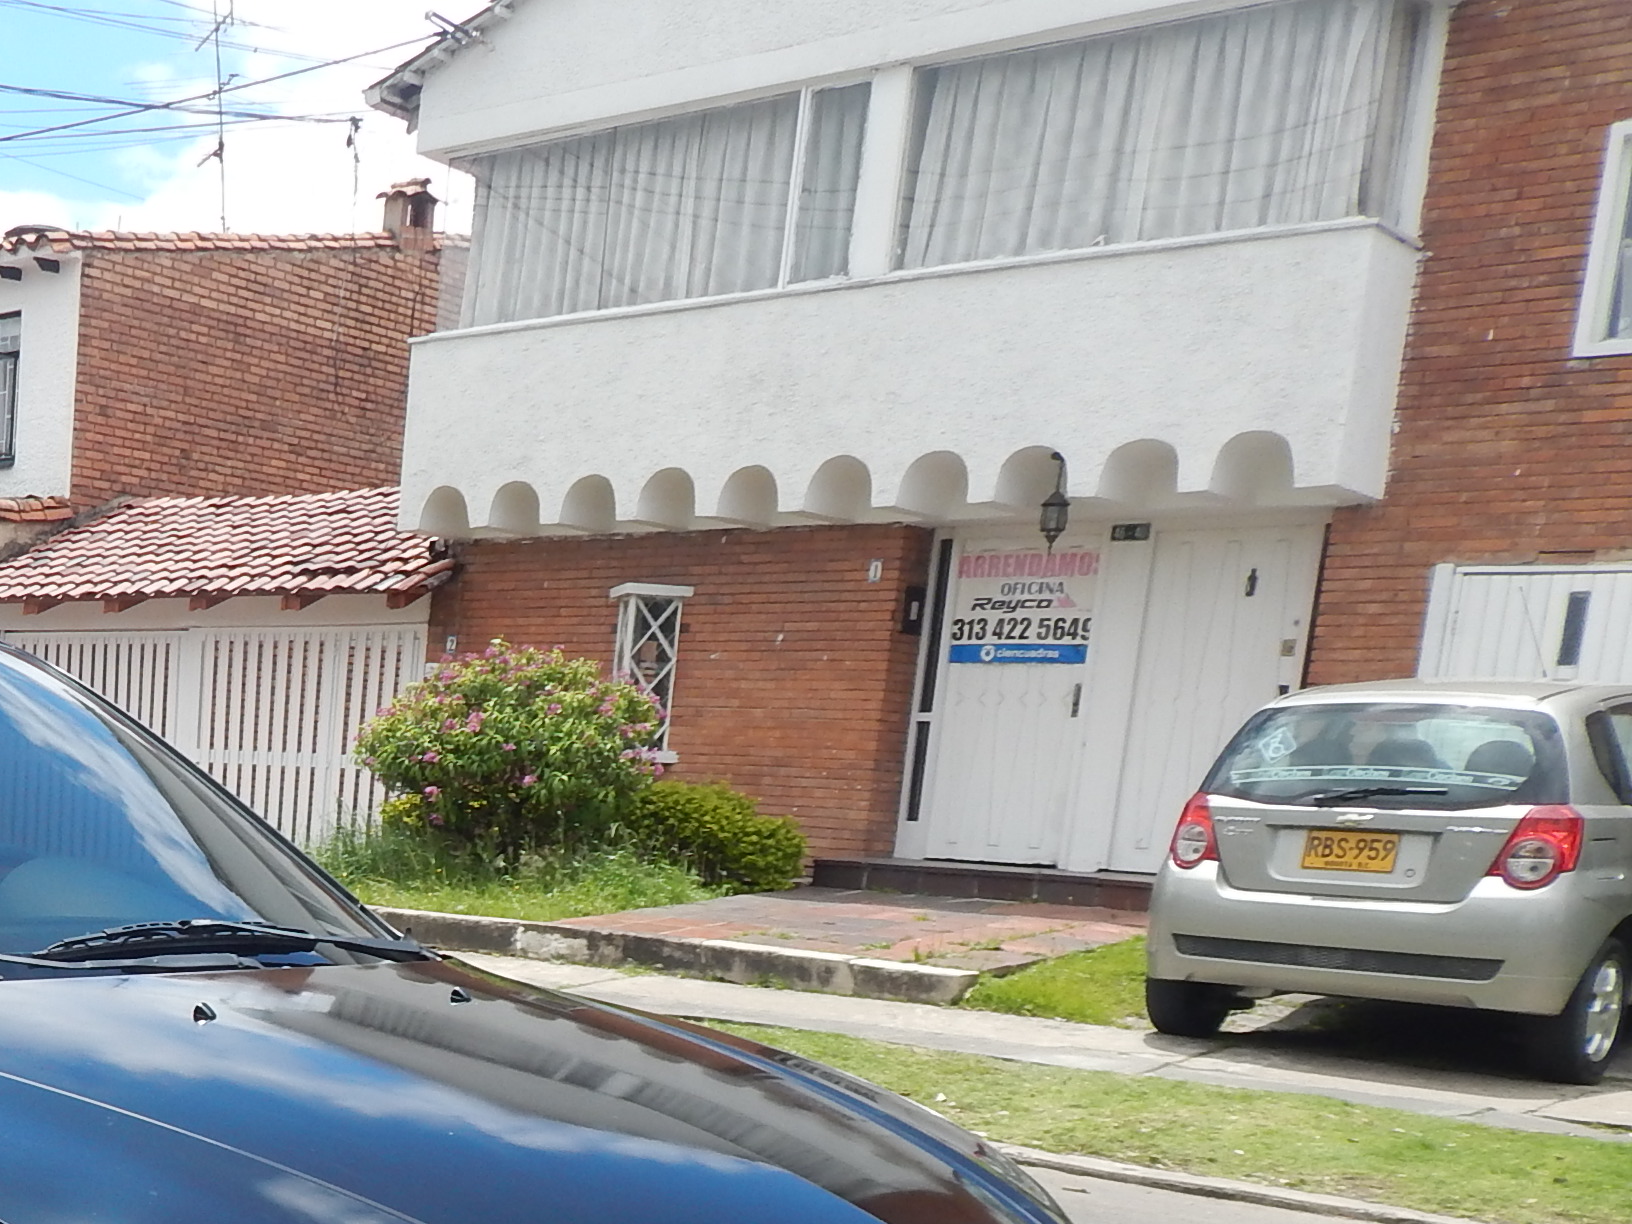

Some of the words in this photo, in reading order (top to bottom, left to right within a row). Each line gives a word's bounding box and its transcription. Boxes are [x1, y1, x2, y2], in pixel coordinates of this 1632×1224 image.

[1000, 582, 1065, 596] OFICINA
[971, 597, 1054, 614] Reyco
[951, 618, 989, 641] 313
[992, 617, 1032, 640] 422
[1036, 617, 1092, 641] 5649
[1306, 835, 1396, 862] RBS-959
